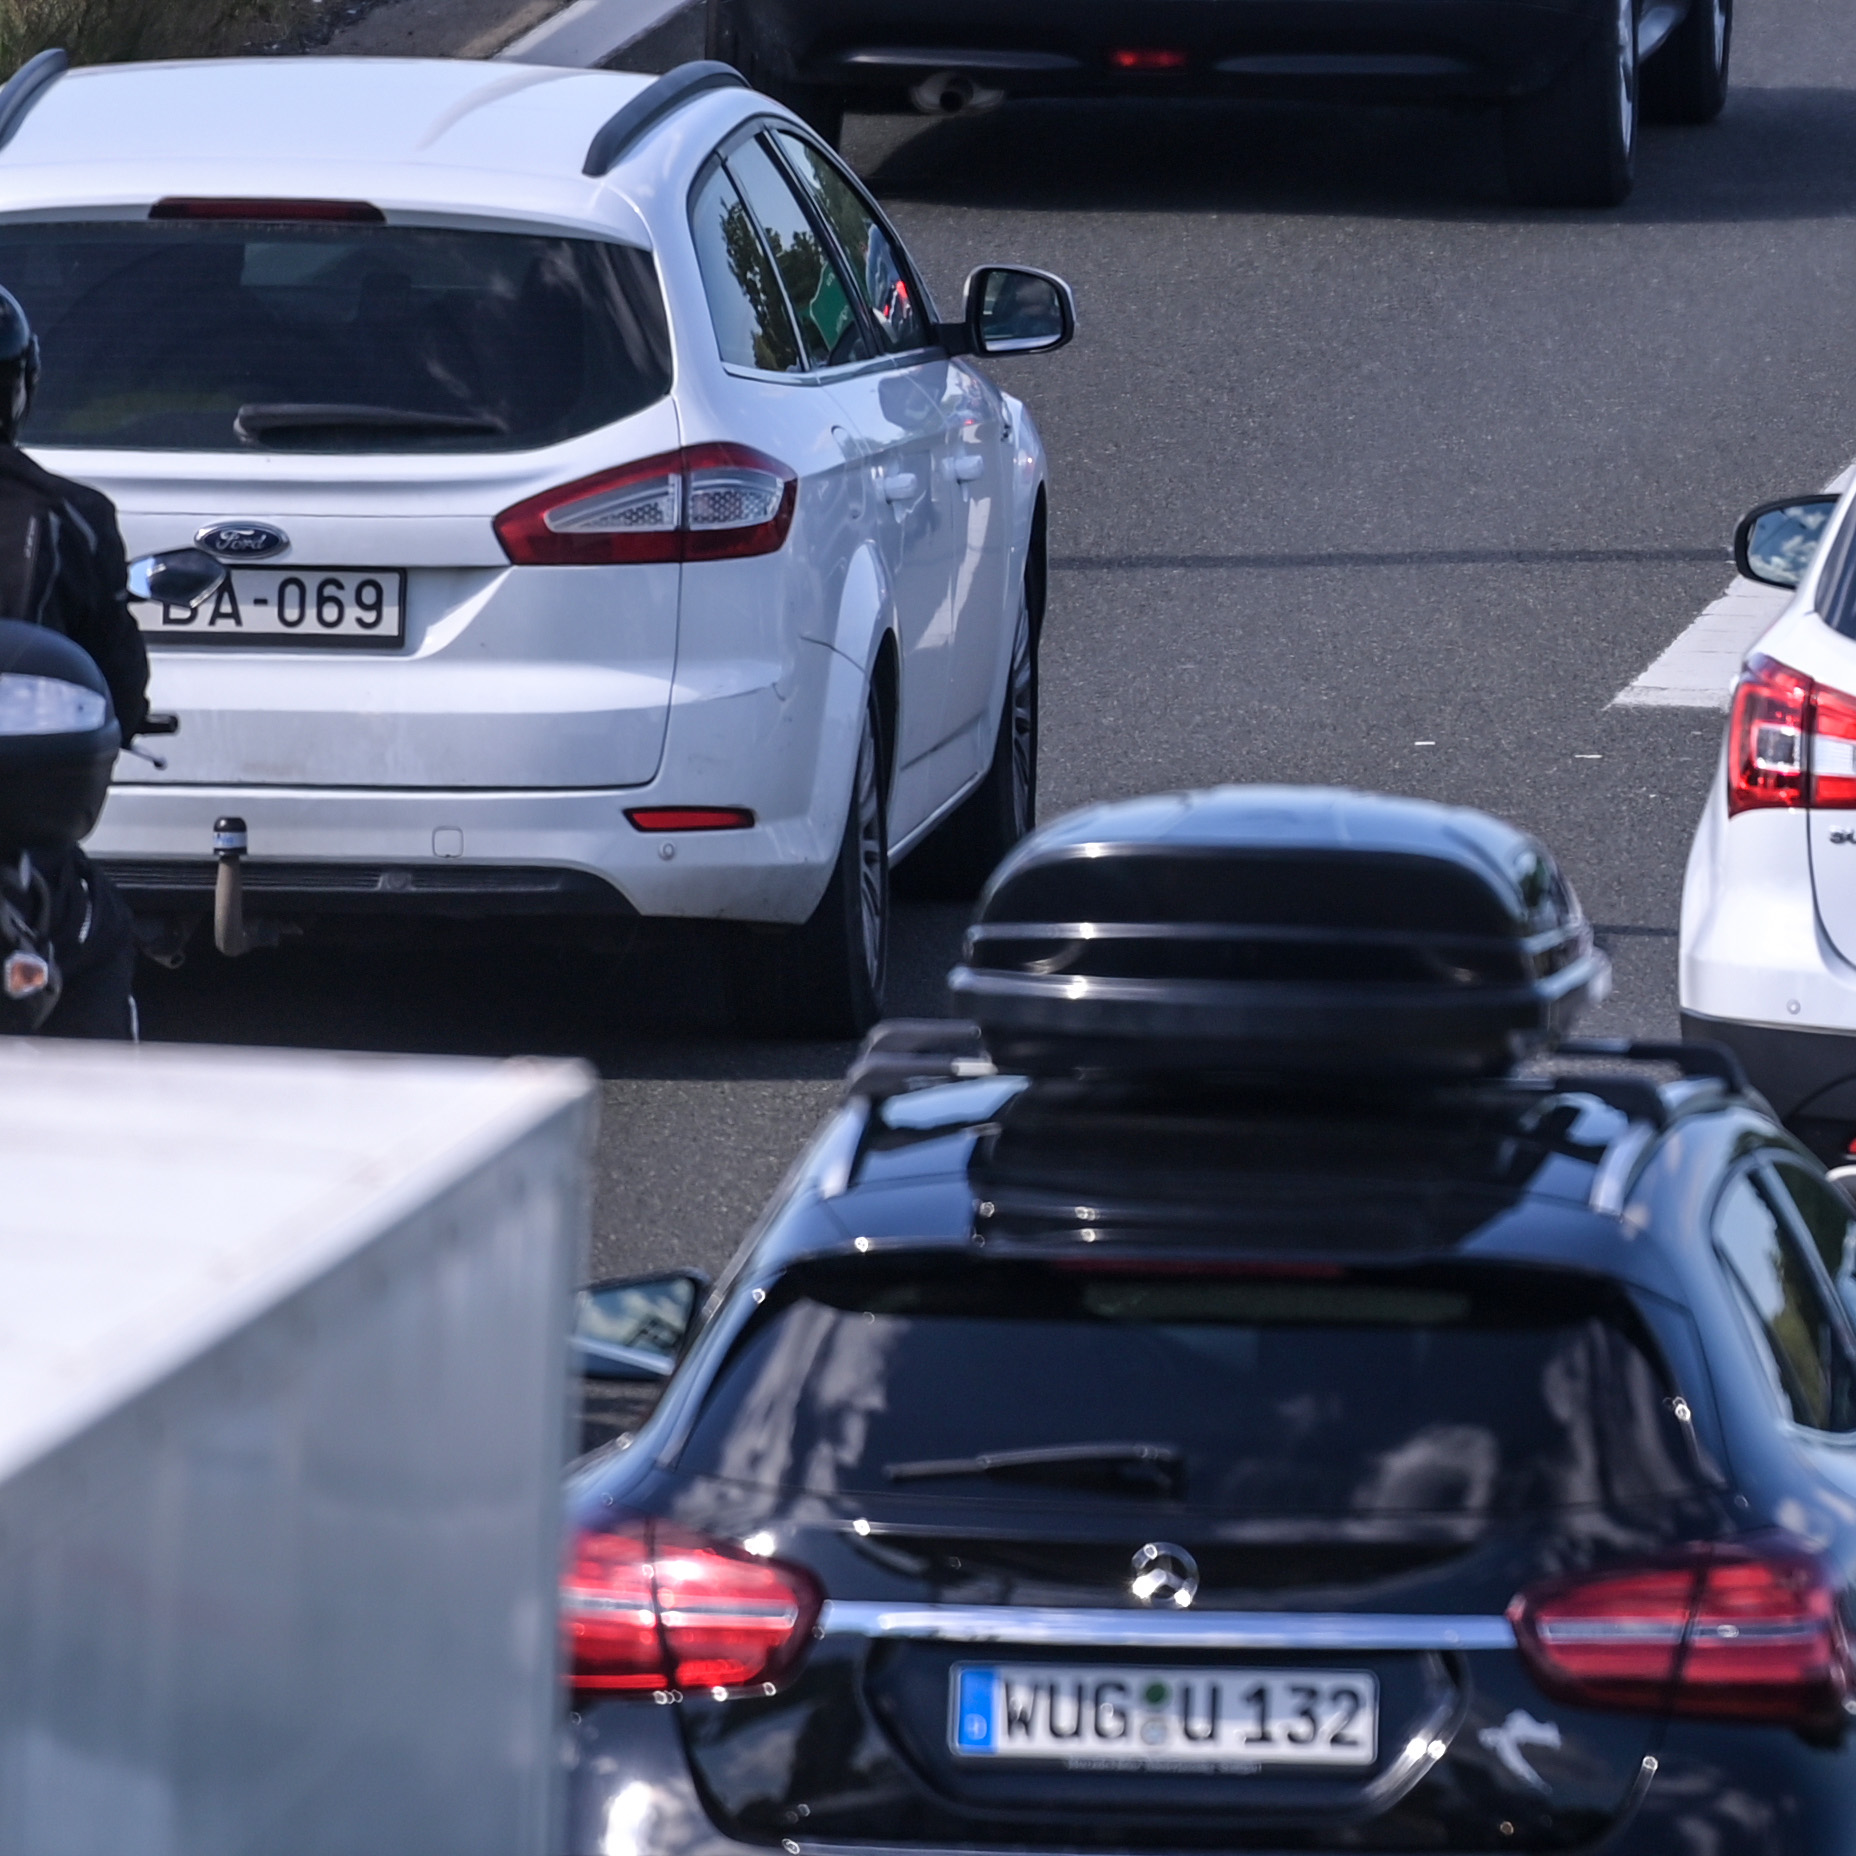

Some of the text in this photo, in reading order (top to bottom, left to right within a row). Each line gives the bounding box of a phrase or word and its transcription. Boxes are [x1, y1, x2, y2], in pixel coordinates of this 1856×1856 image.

[215, 530, 269, 551] Ford
[1003, 1681, 1361, 1746] WUG U 132
